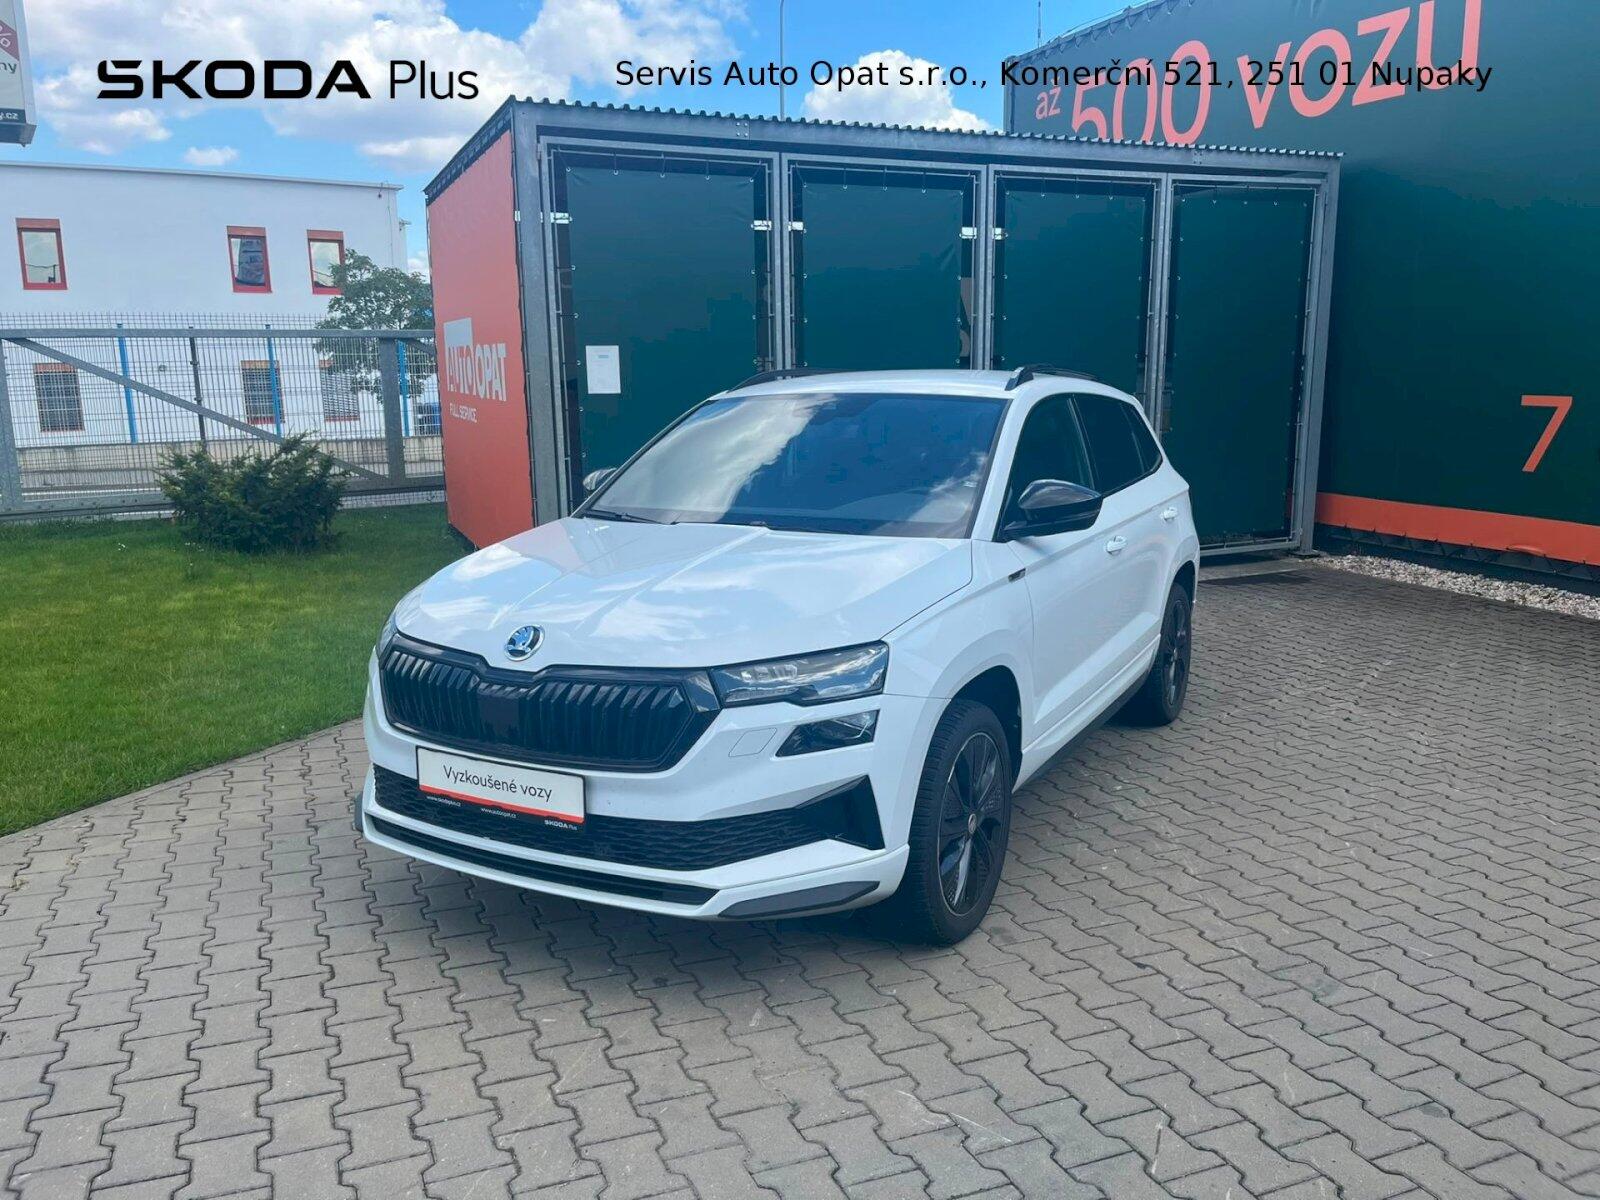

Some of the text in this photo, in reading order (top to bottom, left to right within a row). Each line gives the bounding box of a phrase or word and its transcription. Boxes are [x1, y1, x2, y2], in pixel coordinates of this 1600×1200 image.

[1071, 40, 1212, 146] 500
[475, 342, 507, 402] OPAT
[1521, 394, 1573, 472] 7
[443, 765, 552, 803] Vyzkoušené vozy
